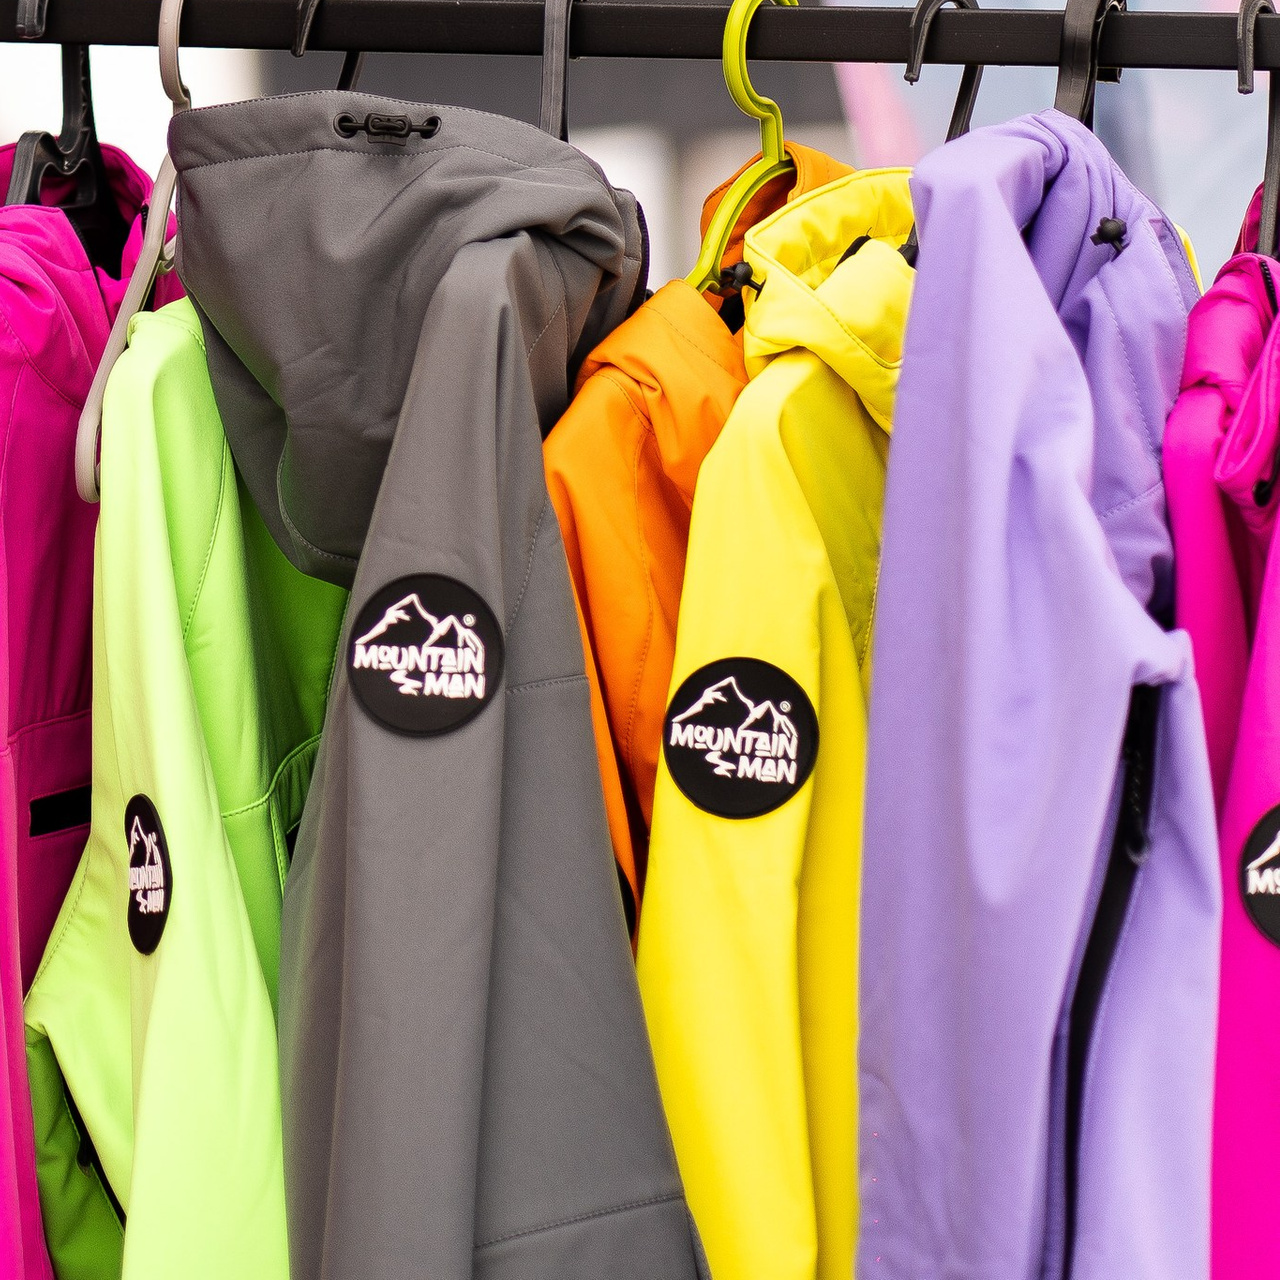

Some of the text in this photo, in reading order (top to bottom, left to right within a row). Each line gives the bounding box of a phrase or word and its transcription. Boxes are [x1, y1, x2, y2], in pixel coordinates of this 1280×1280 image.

[353, 644, 486, 673] MOUNTAIN
[423, 672, 486, 699] MAN
[670, 723, 798, 760] MOUNTAIN
[737, 755, 797, 784] MAN
